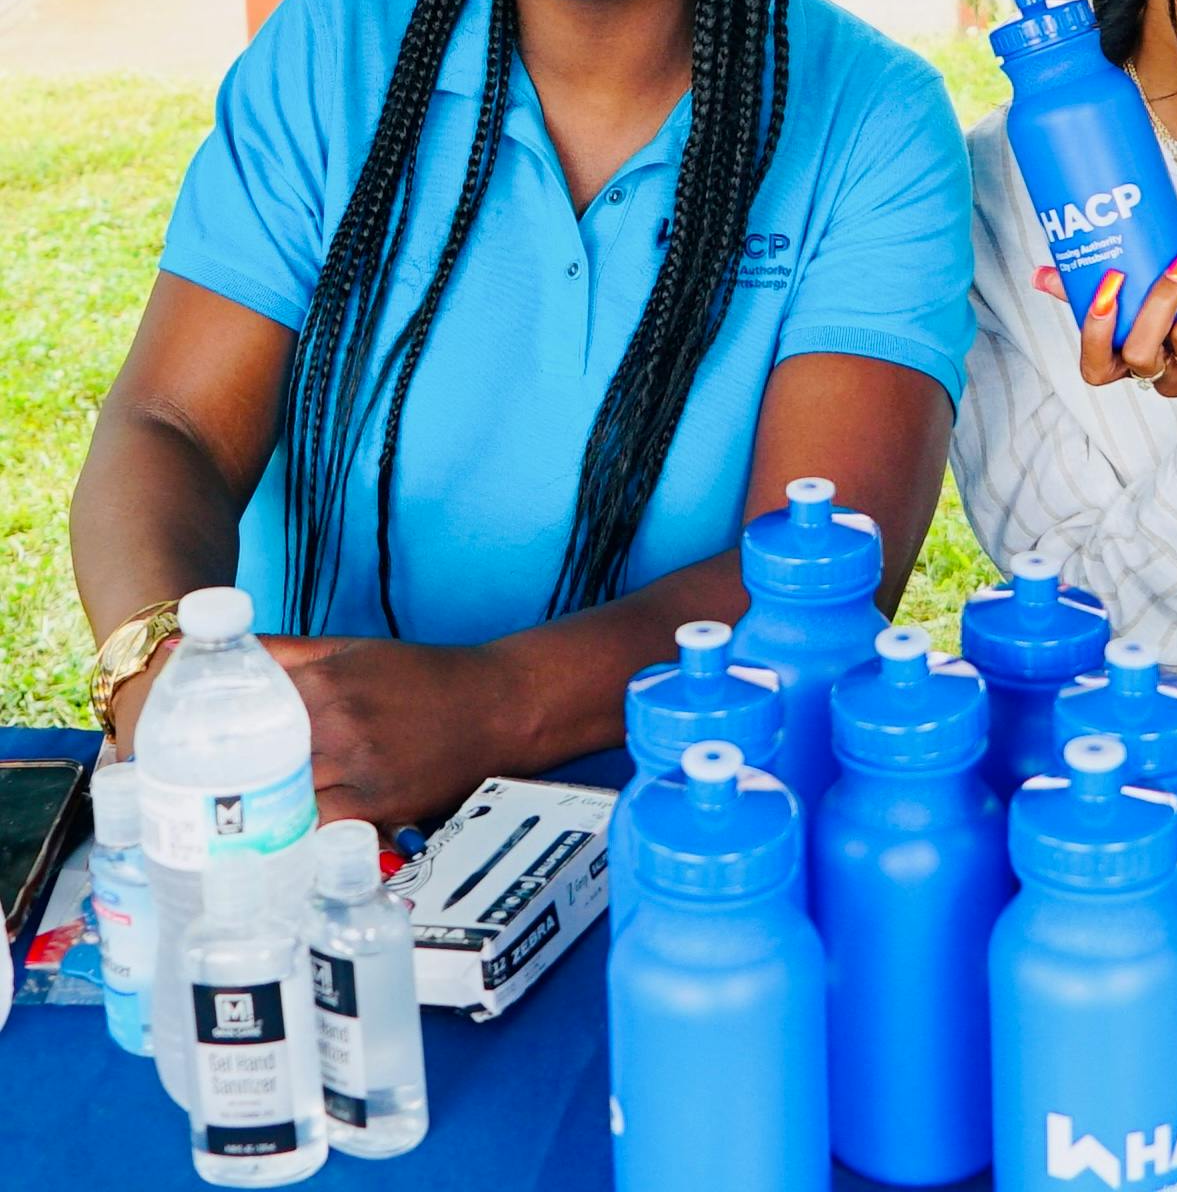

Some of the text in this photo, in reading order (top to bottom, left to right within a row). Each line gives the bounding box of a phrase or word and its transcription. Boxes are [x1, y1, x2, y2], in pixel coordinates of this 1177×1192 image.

[1040, 183, 1142, 243] HACP
[743, 233, 791, 260] CP
[1080, 234, 1123, 255] Authority
[1077, 246, 1124, 268] Pittsburgh
[740, 265, 793, 278] Authority
[510, 914, 557, 966] ZEBRA
